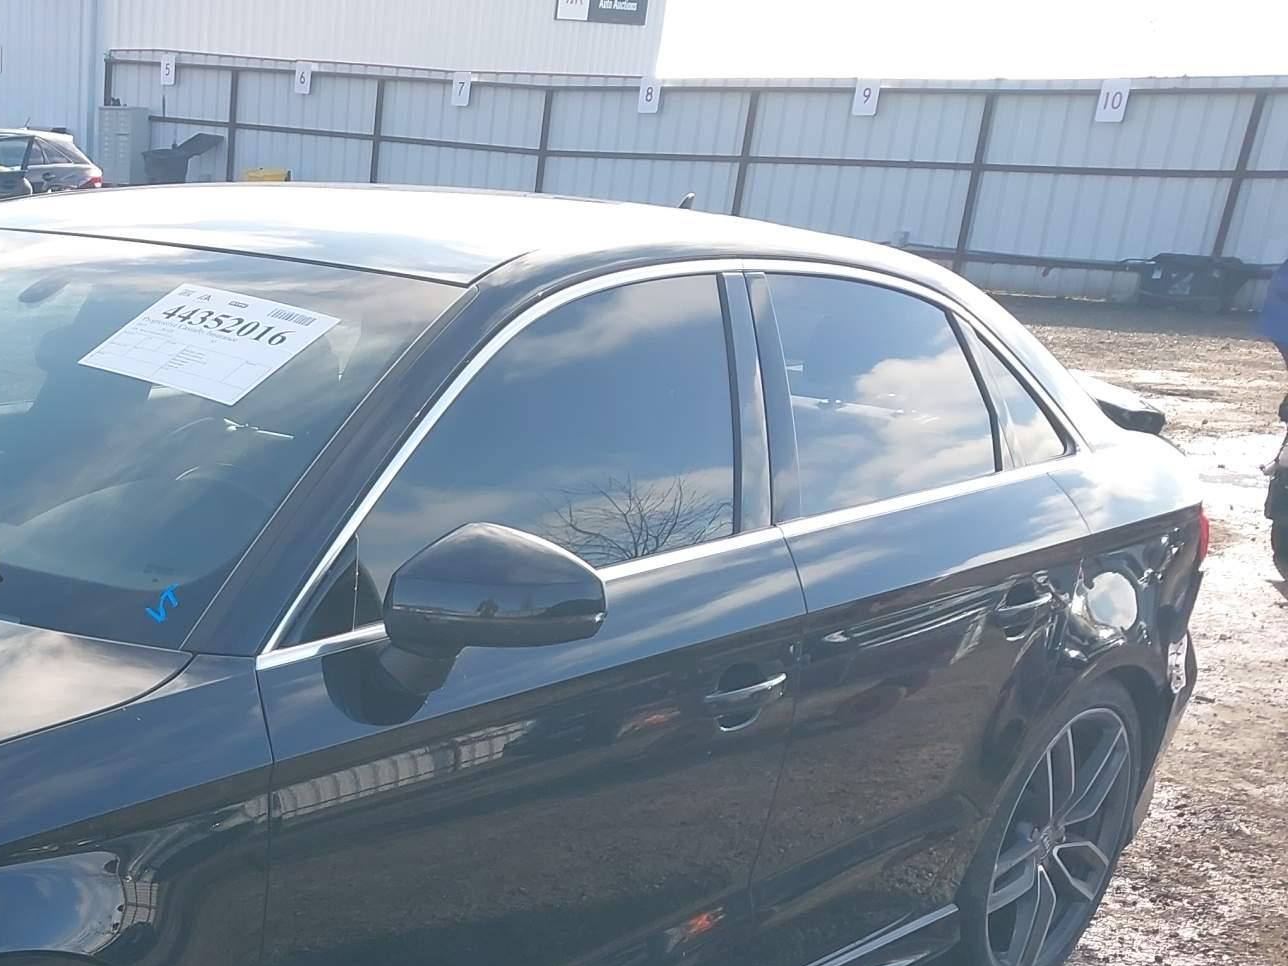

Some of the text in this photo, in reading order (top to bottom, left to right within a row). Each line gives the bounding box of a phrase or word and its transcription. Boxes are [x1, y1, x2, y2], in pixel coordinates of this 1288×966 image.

[598, 0, 638, 11] Auto Auctions
[165, 63, 171, 76] 5
[299, 71, 306, 84] 6
[458, 81, 465, 96] 7
[645, 86, 654, 102] 8
[863, 87, 872, 104] 9
[1103, 91, 1122, 110] 10
[162, 304, 296, 346] 44352016
